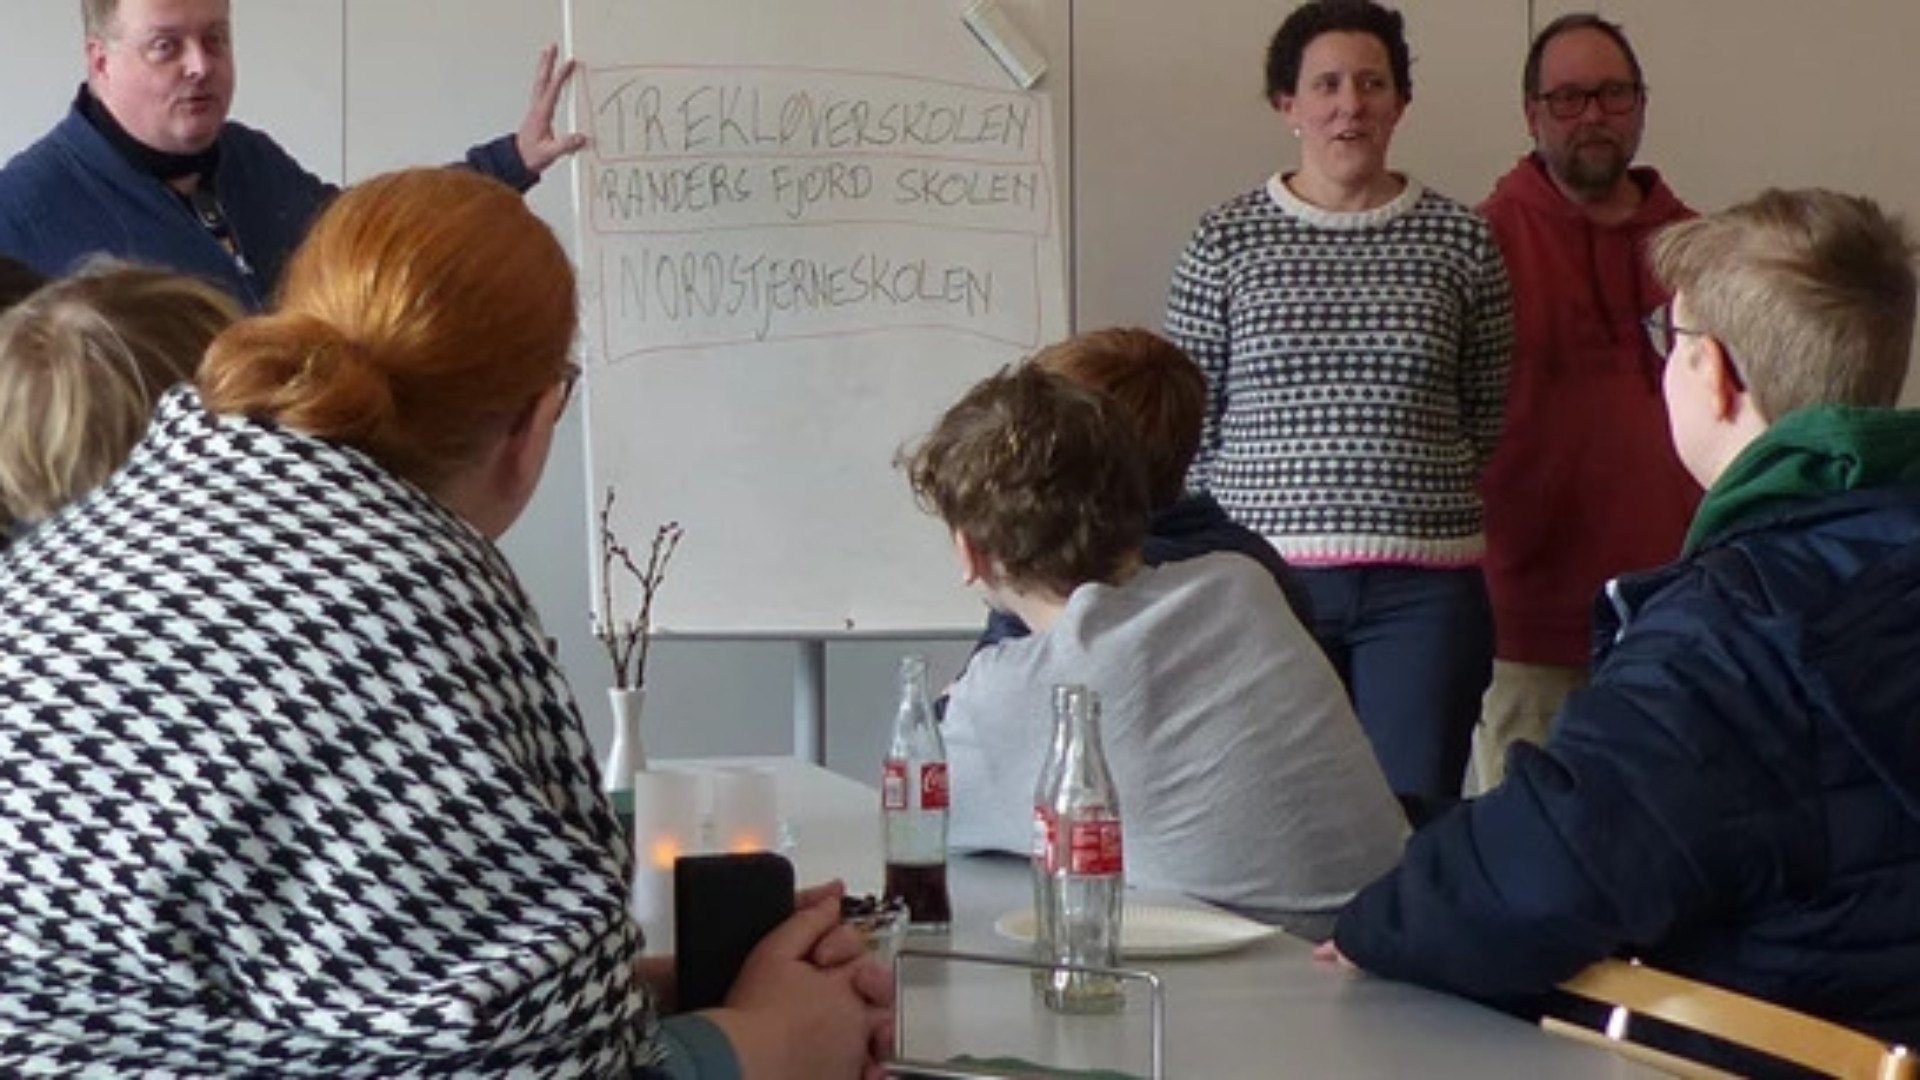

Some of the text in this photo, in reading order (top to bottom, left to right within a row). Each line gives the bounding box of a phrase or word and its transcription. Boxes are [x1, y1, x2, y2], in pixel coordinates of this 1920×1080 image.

[599, 78, 1030, 151] TREKLØVERSKOLEN
[602, 161, 752, 219] RANDERS
[896, 167, 1038, 211] SKOLEN
[619, 247, 993, 342] NORDSTJERNESKOLEN
